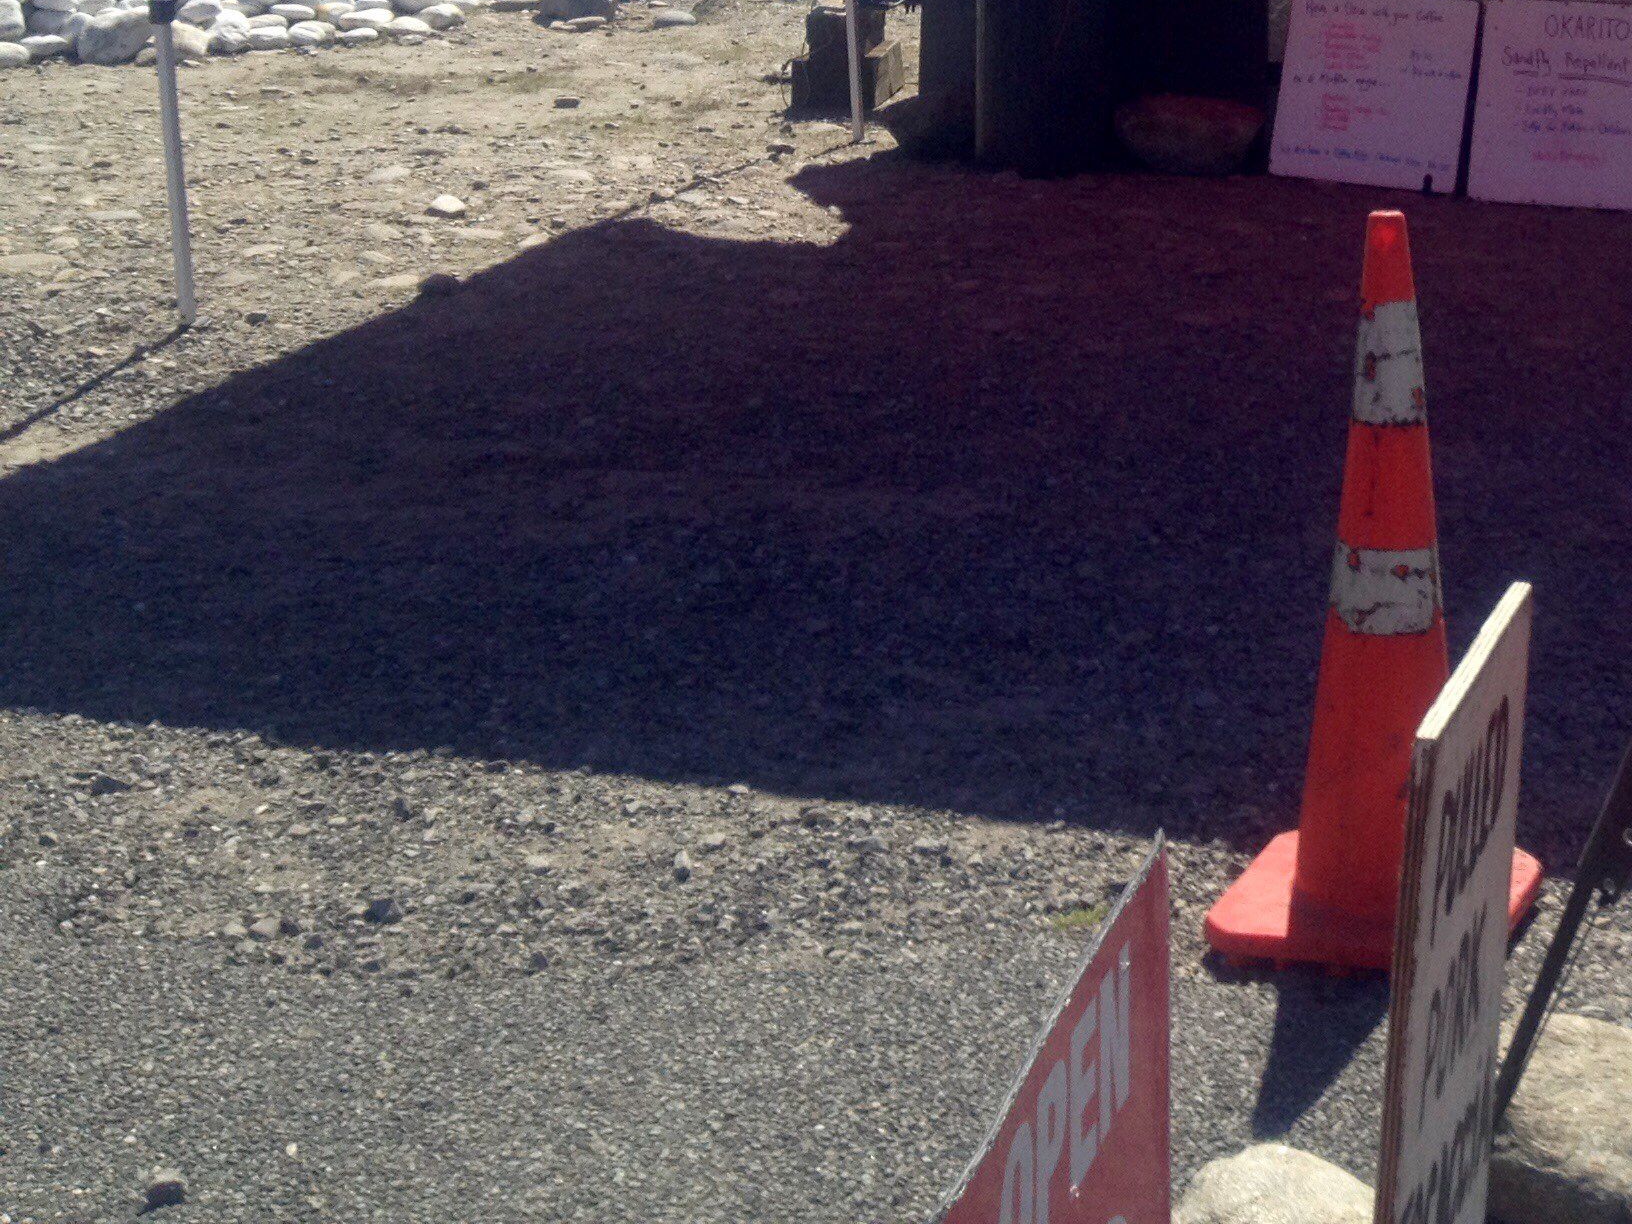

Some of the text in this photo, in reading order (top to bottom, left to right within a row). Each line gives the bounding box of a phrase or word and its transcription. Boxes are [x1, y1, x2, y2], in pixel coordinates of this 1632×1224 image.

[1544, 14, 1632, 42] OKARITO
[1502, 45, 1552, 73] Sandfly
[1003, 940, 1131, 1224] OPEN
